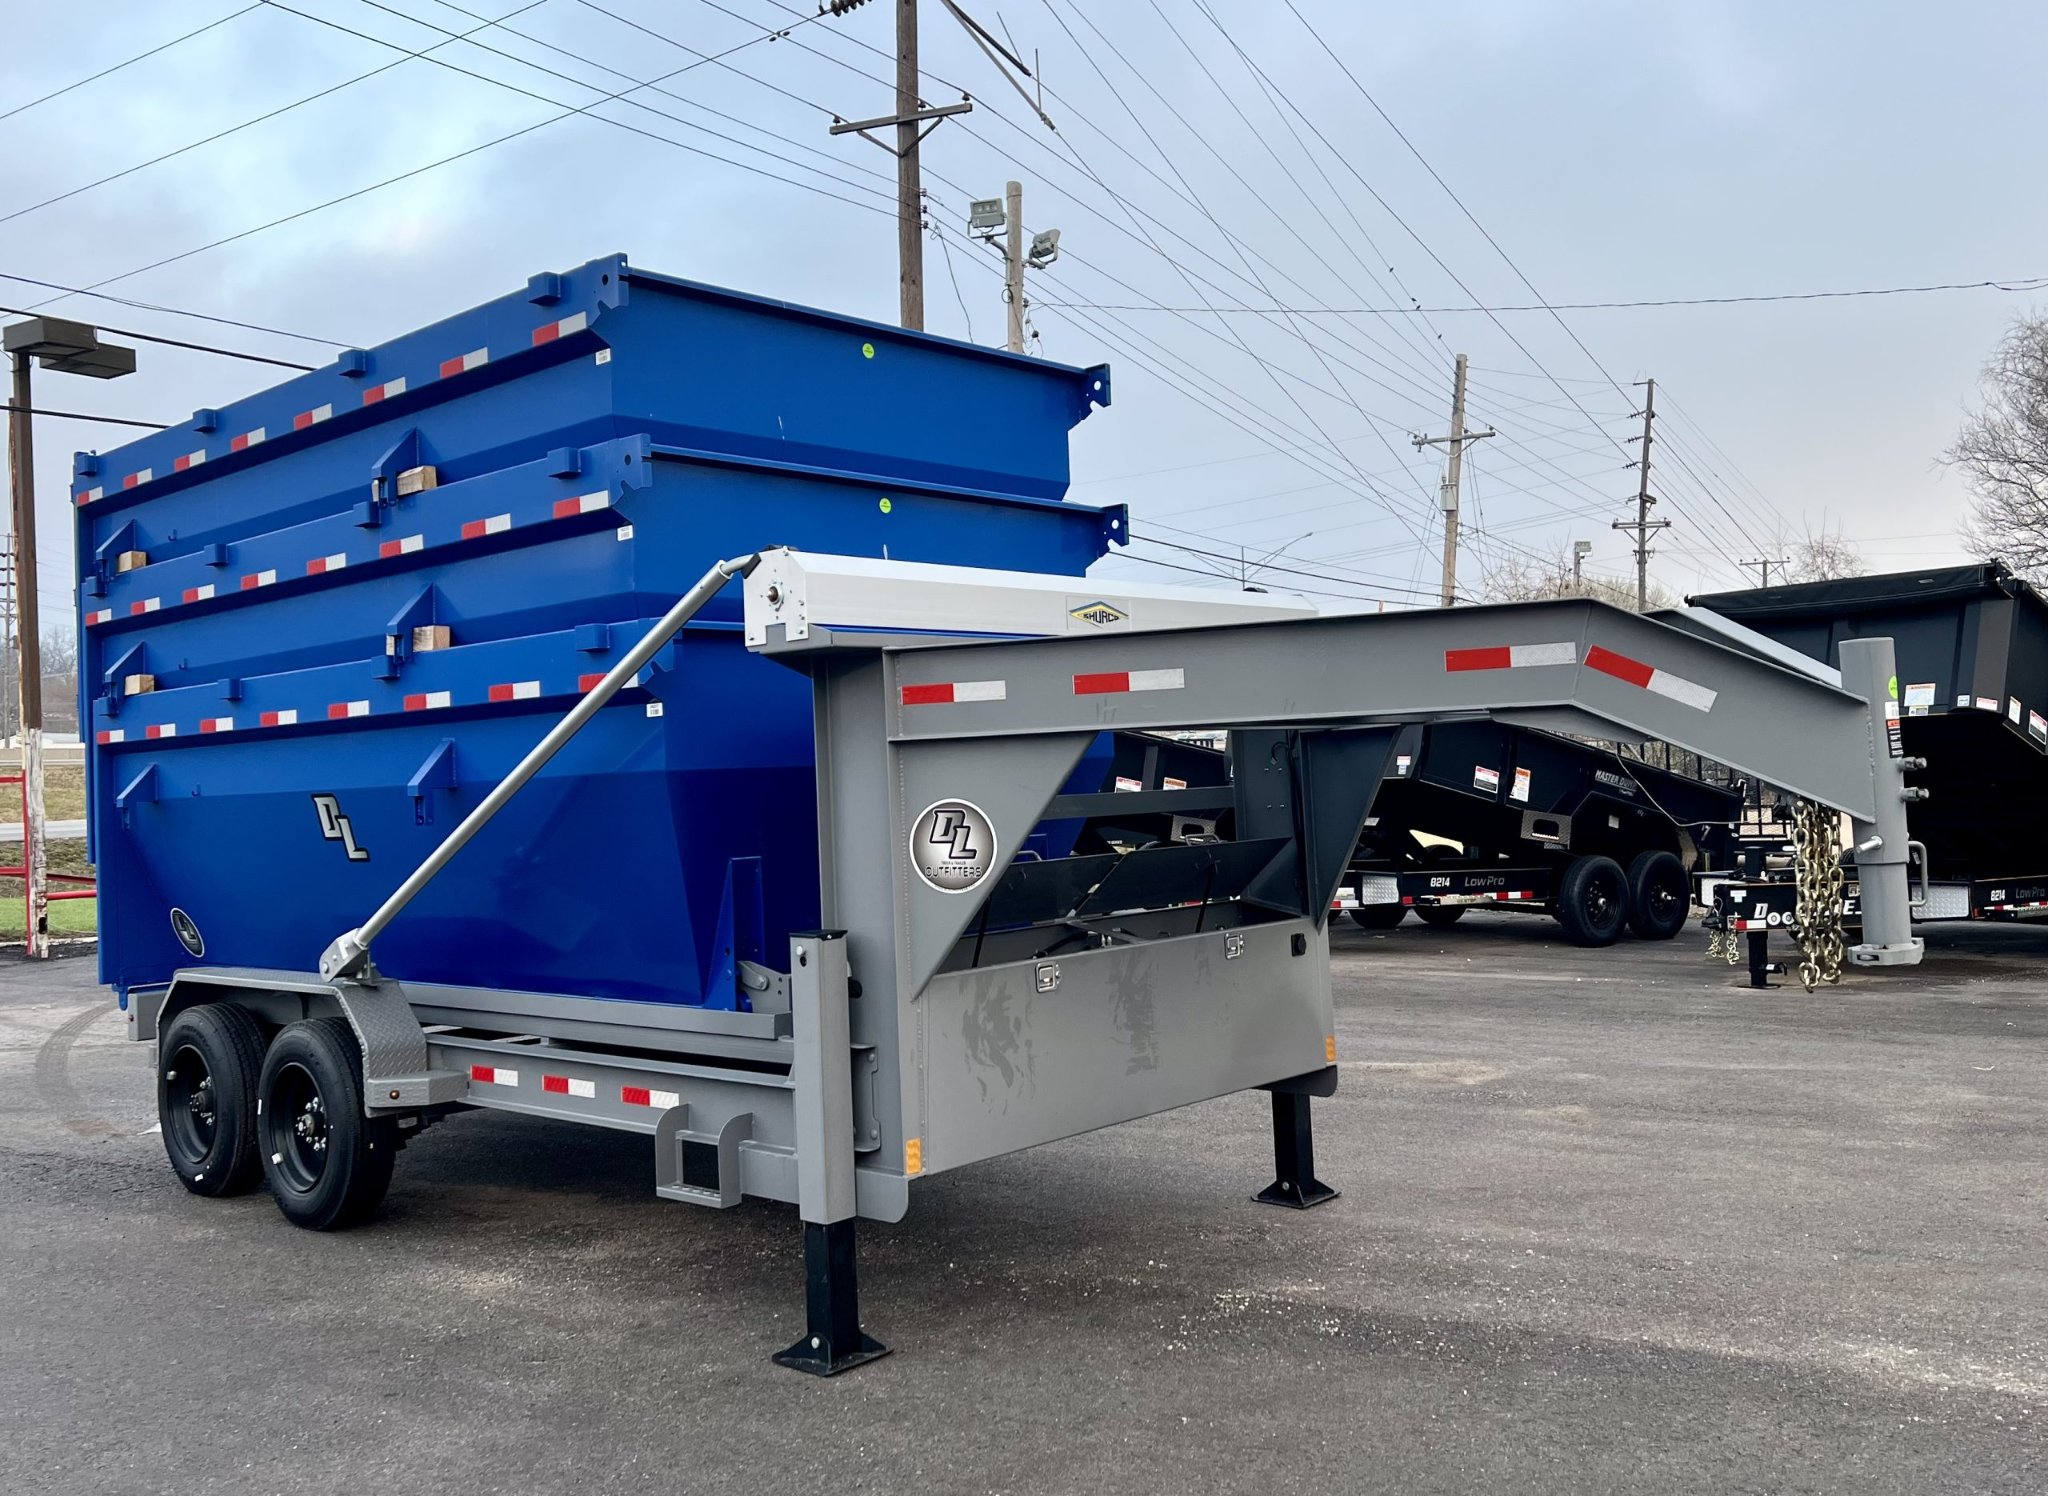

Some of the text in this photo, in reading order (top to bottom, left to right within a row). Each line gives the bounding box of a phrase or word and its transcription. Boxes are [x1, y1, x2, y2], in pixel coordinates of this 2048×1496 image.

[1595, 769, 1619, 785] MASTER
[925, 866, 981, 878] OUTFITTERS
[1430, 877, 1450, 887] 8214
[1990, 889, 2006, 901] 8214
